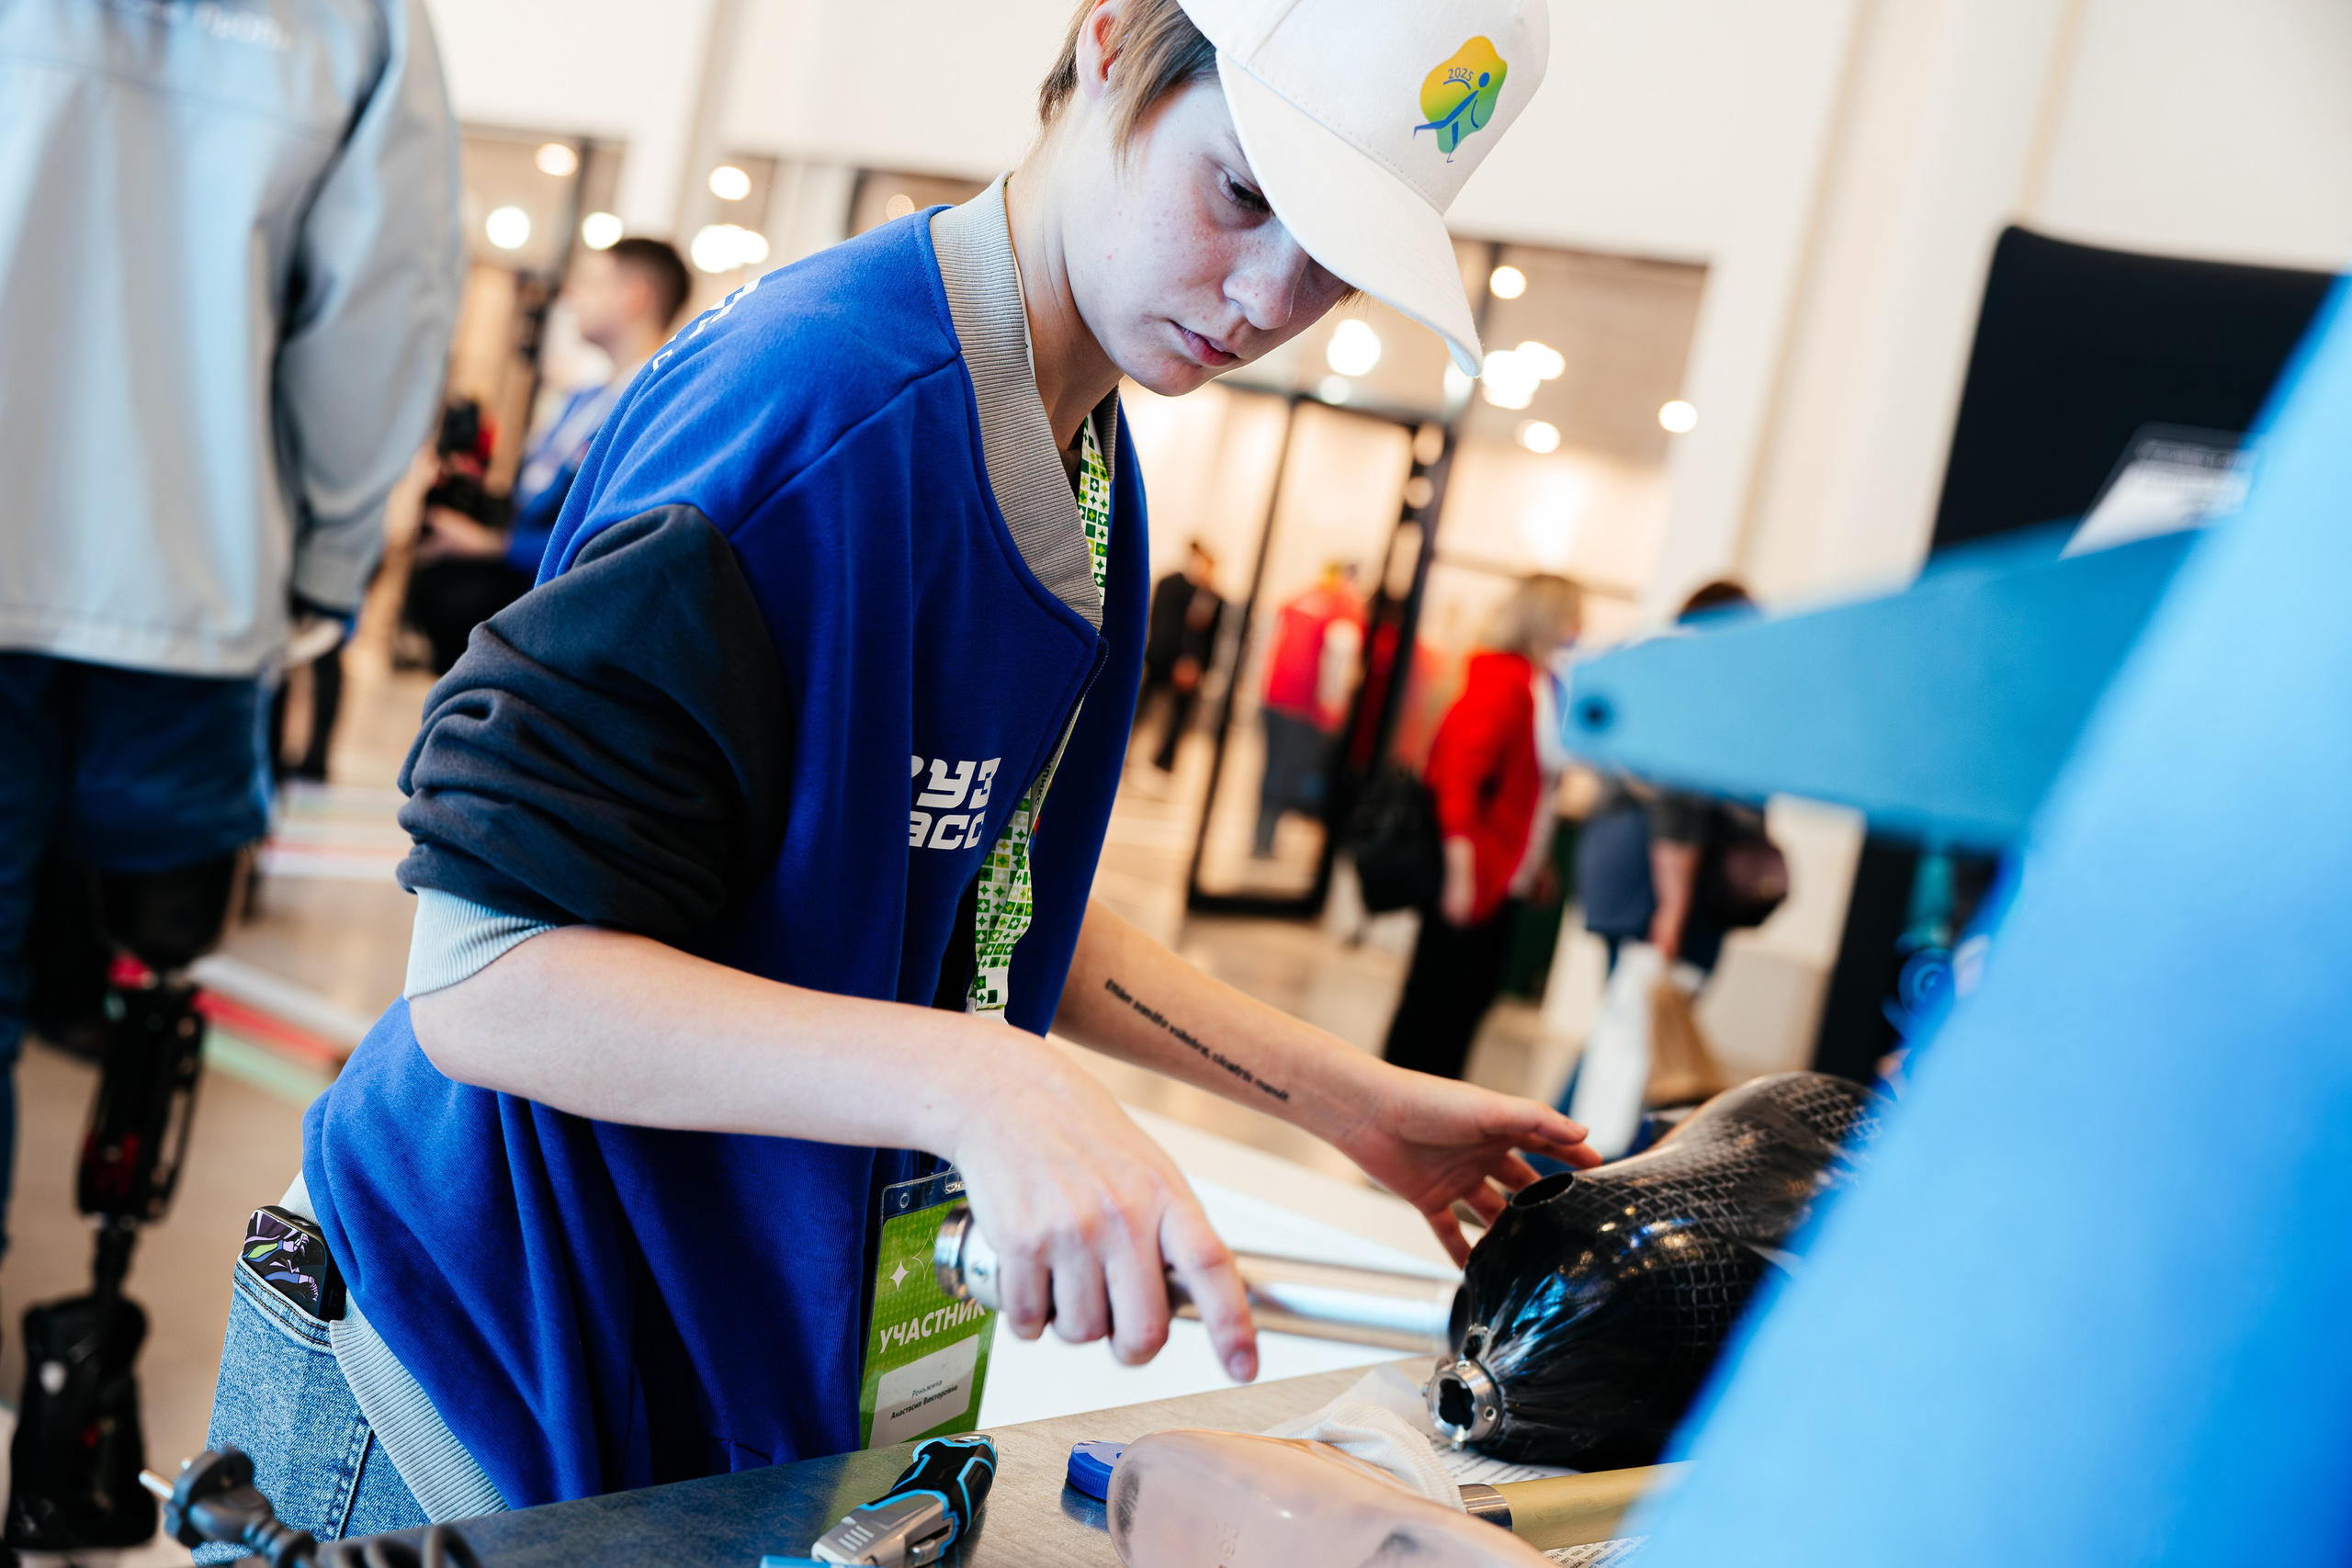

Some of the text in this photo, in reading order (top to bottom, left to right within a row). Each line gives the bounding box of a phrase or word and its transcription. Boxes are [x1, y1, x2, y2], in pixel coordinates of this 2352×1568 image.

[1448, 67, 1474, 82] 2025
[879, 1303, 986, 1355] УЧАСТНИК
[890, 1401, 922, 1420] Анастасия
